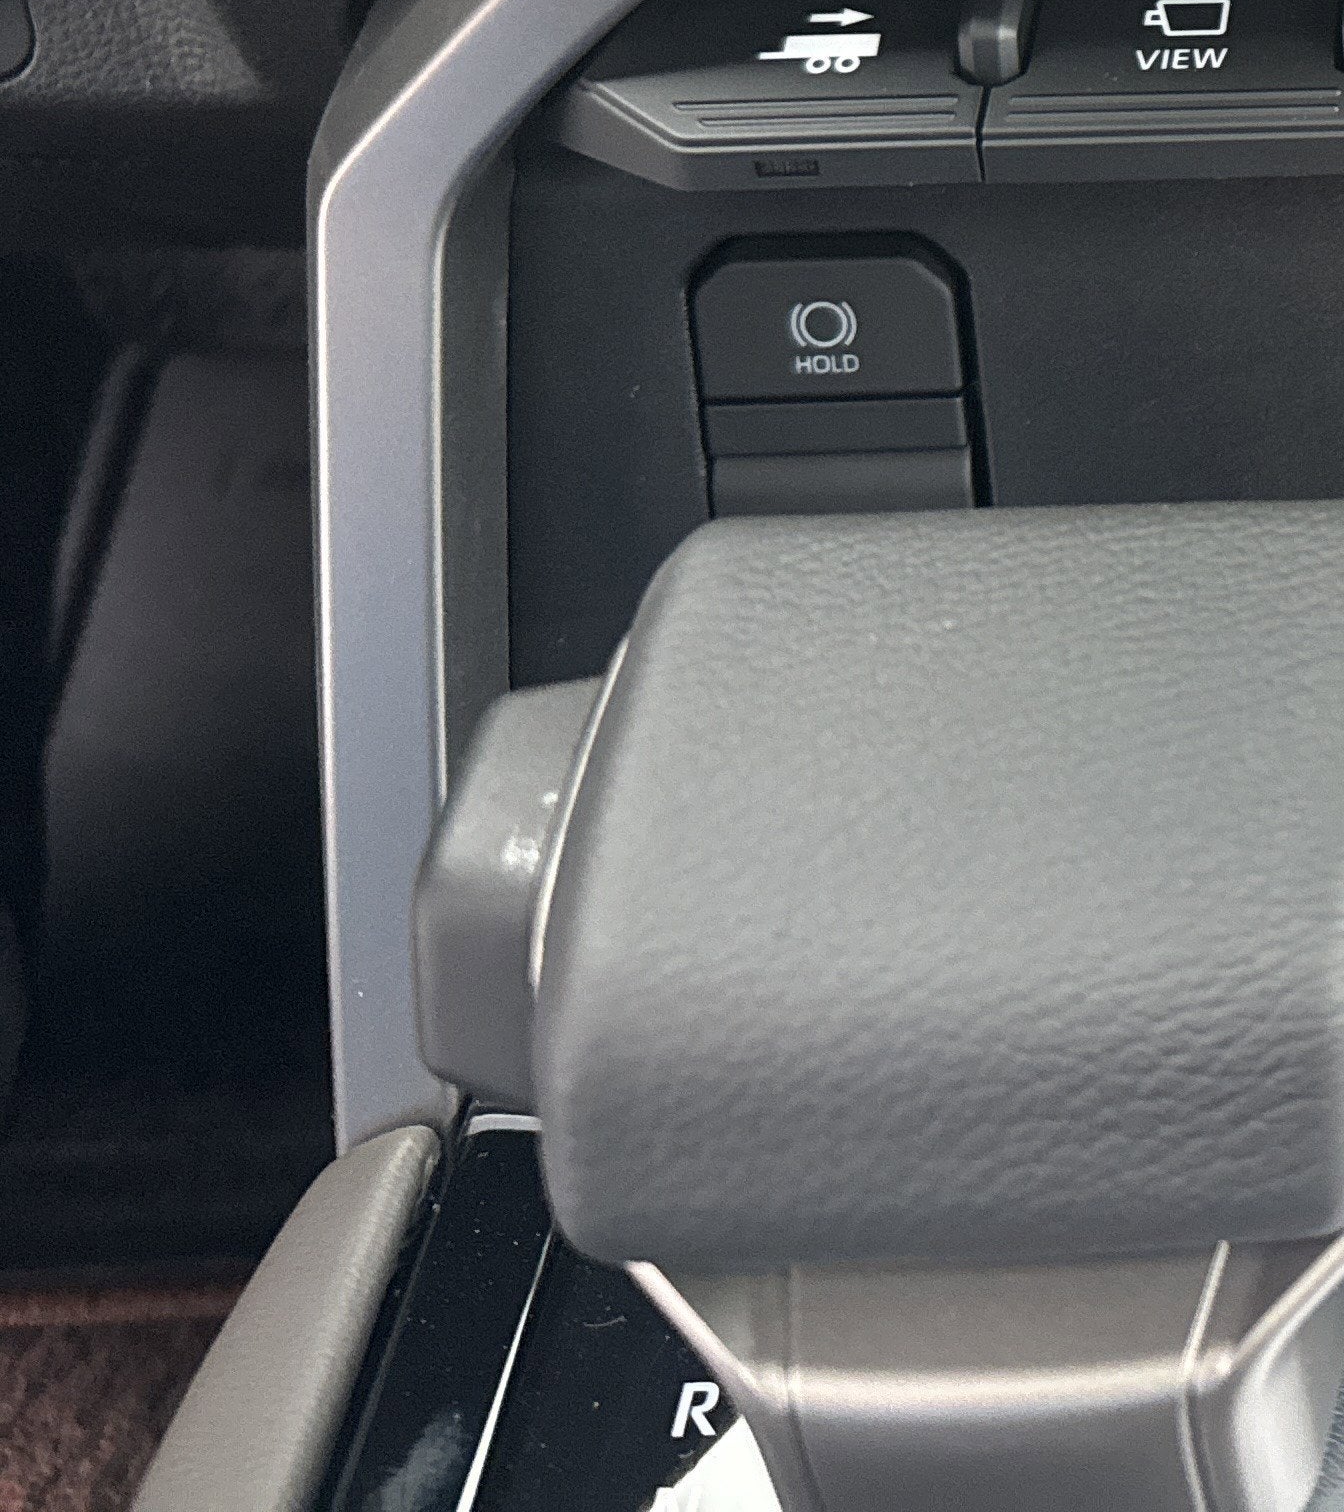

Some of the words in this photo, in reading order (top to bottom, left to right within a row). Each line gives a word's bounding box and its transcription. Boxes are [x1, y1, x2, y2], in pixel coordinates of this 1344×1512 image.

[1133, 48, 1230, 71] VIEW
[793, 354, 861, 375] HOLD
[670, 1381, 720, 1438] R
